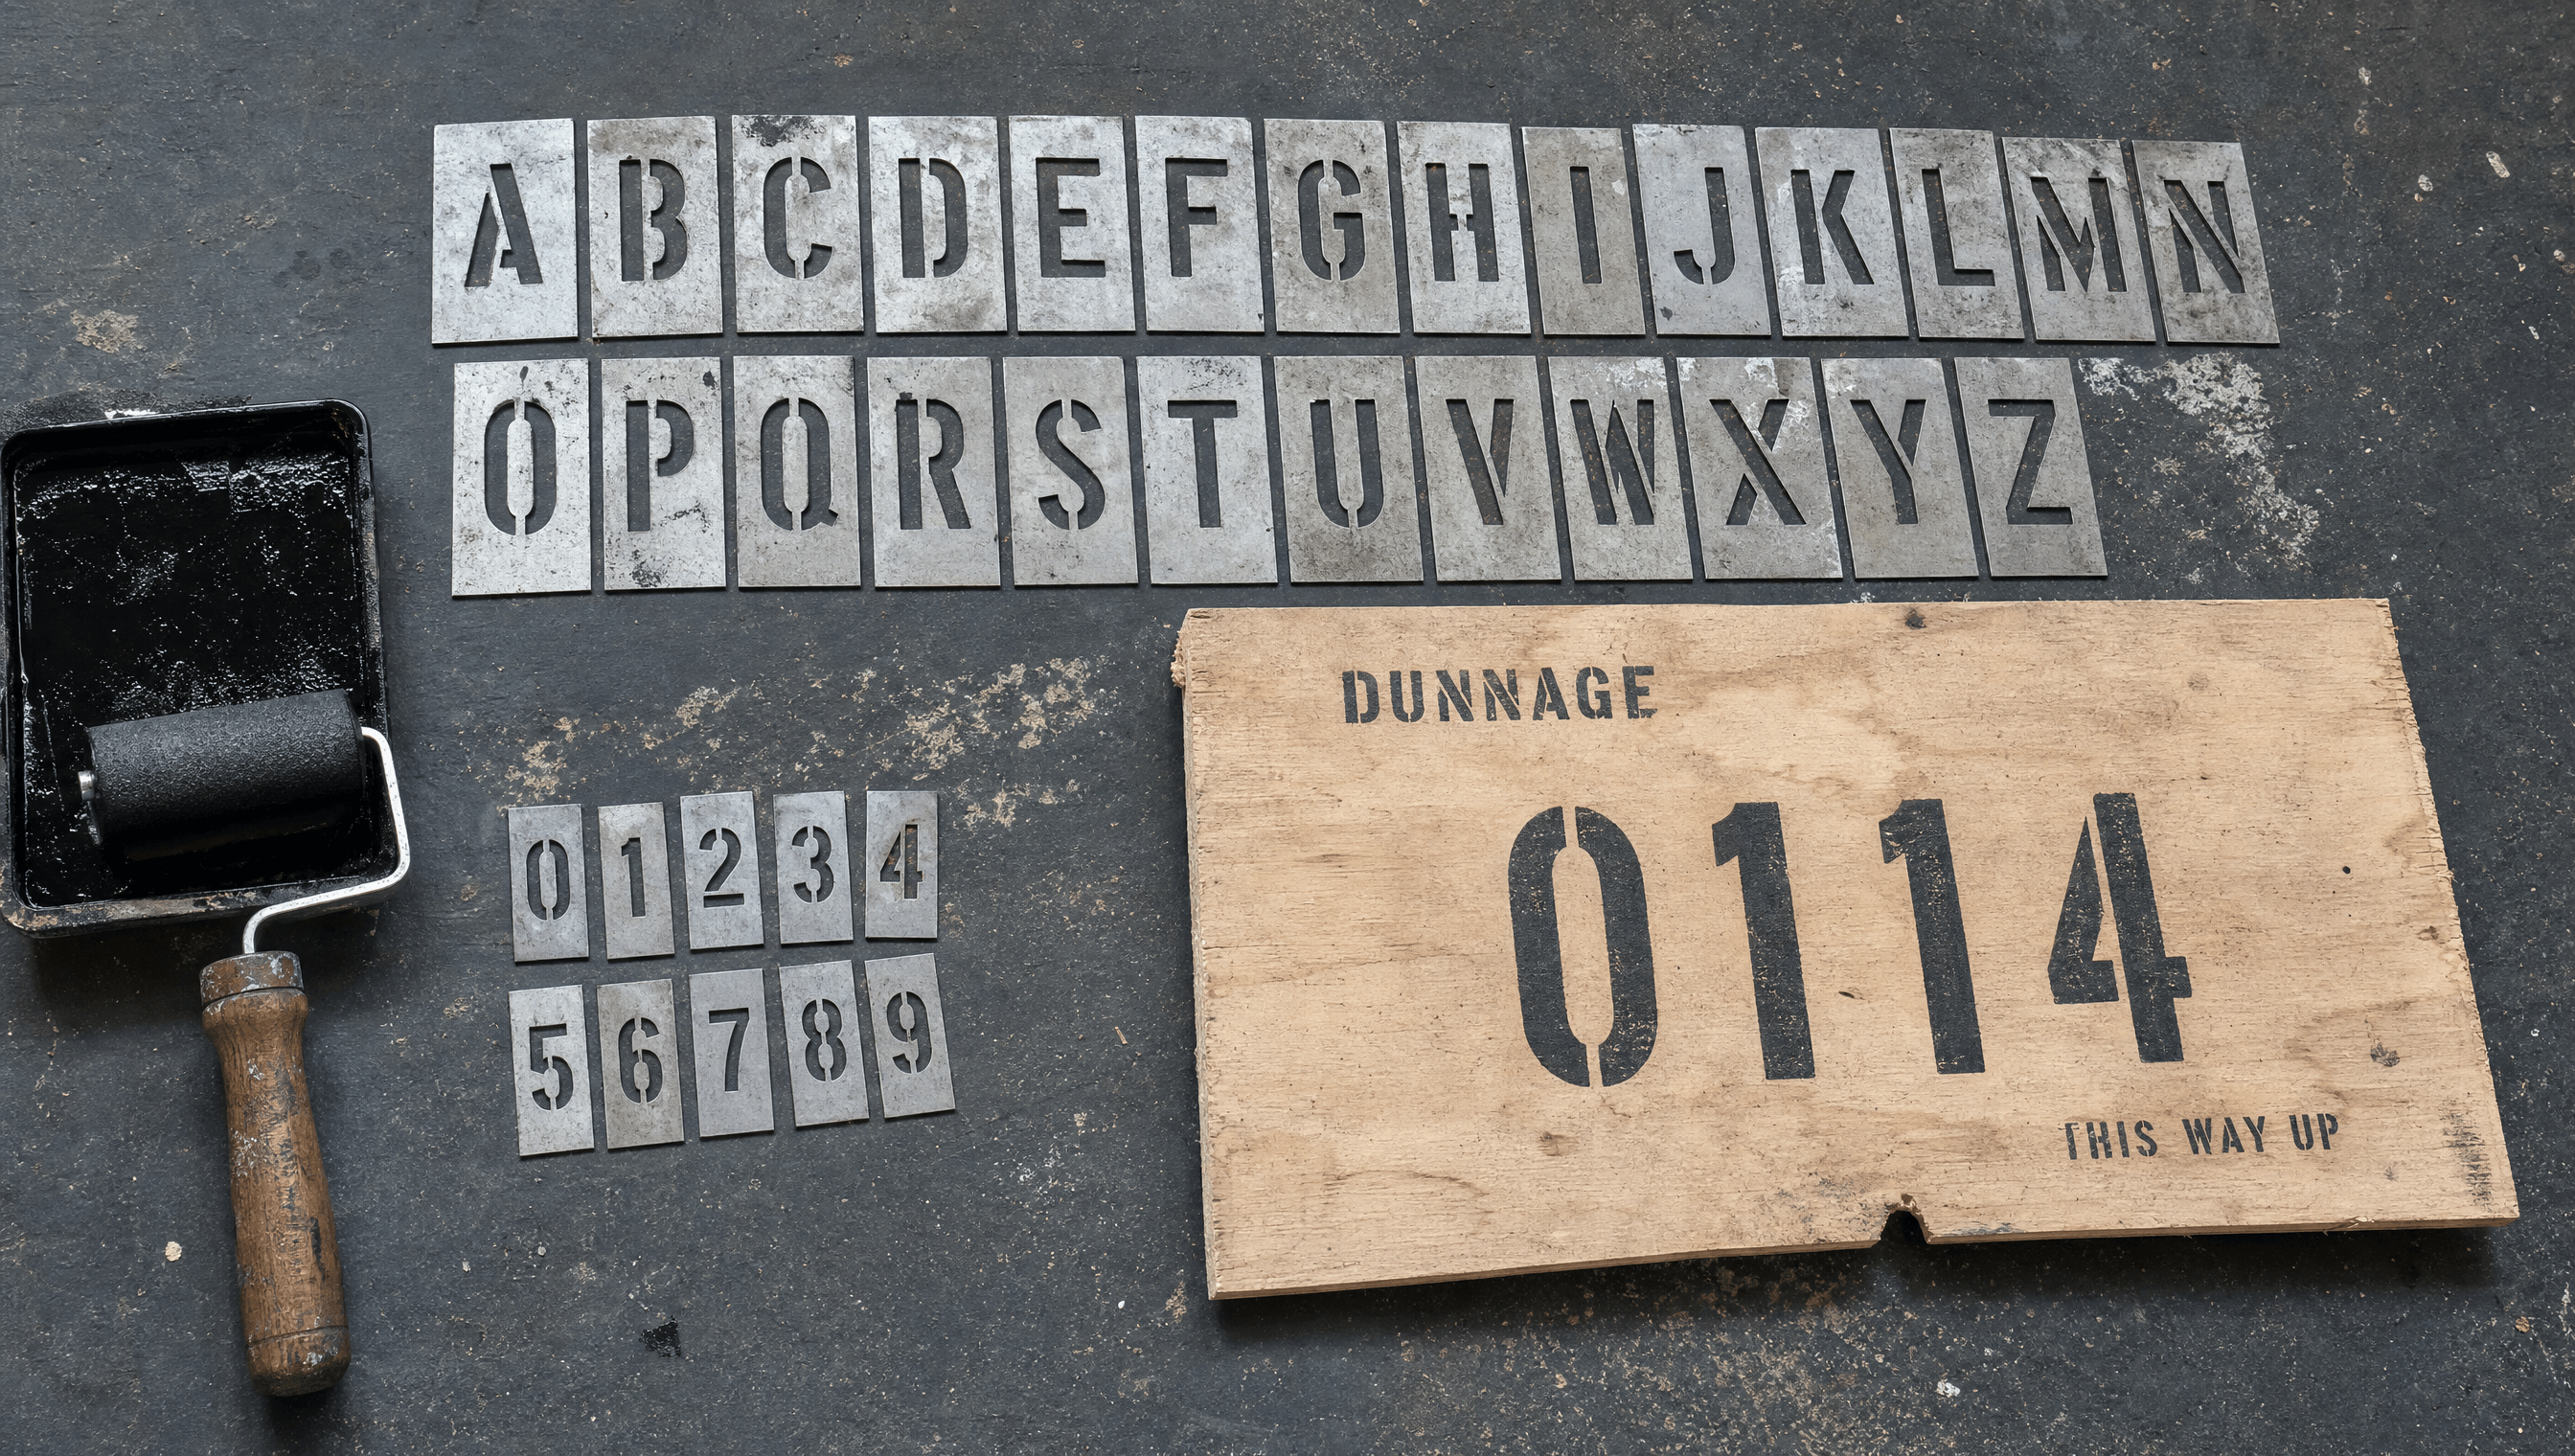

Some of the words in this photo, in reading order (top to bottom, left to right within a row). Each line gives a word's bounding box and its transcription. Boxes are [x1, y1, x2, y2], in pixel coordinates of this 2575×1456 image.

[465, 163, 543, 286] A
[620, 158, 688, 282] B
[763, 157, 832, 280] C
[898, 158, 968, 278] D
[1036, 158, 1105, 278] E
[1165, 158, 1227, 277] F
[1298, 159, 1365, 282] G
[1424, 163, 1499, 282] H
[1570, 166, 1602, 284] I
[1674, 167, 1735, 284] J
[1790, 170, 1874, 284] K
[1922, 169, 1994, 285] L
[2030, 177, 2127, 292] M
[2164, 179, 2245, 293] N
[484, 399, 556, 535] O
[626, 399, 695, 532] P
[761, 398, 838, 531] Q
[897, 398, 971, 530] R
[1036, 398, 1105, 530] S
[1168, 399, 1237, 528] T
[1310, 398, 1384, 529] U
[1446, 398, 1515, 525] V
[1570, 398, 1654, 525] W
[1709, 398, 1806, 525] X
[1851, 398, 1926, 524] Y
[1987, 398, 2073, 524] Z
[1341, 666, 1657, 724] DUNNAGE
[526, 839, 570, 921] 0
[621, 837, 646, 917] 1
[698, 827, 744, 907] 2
[791, 826, 833, 902] 3
[879, 825, 923, 899] 4
[1508, 792, 2192, 1087] 0114
[529, 1023, 574, 1110] 5
[618, 1017, 663, 1103] 6
[709, 1008, 749, 1092] 7
[802, 998, 846, 1081] 8
[886, 990, 932, 1074] 9
[2058, 1120, 2157, 1160] THIS
[2181, 1116, 2266, 1154] WAY
[2290, 1113, 2339, 1151] UP
